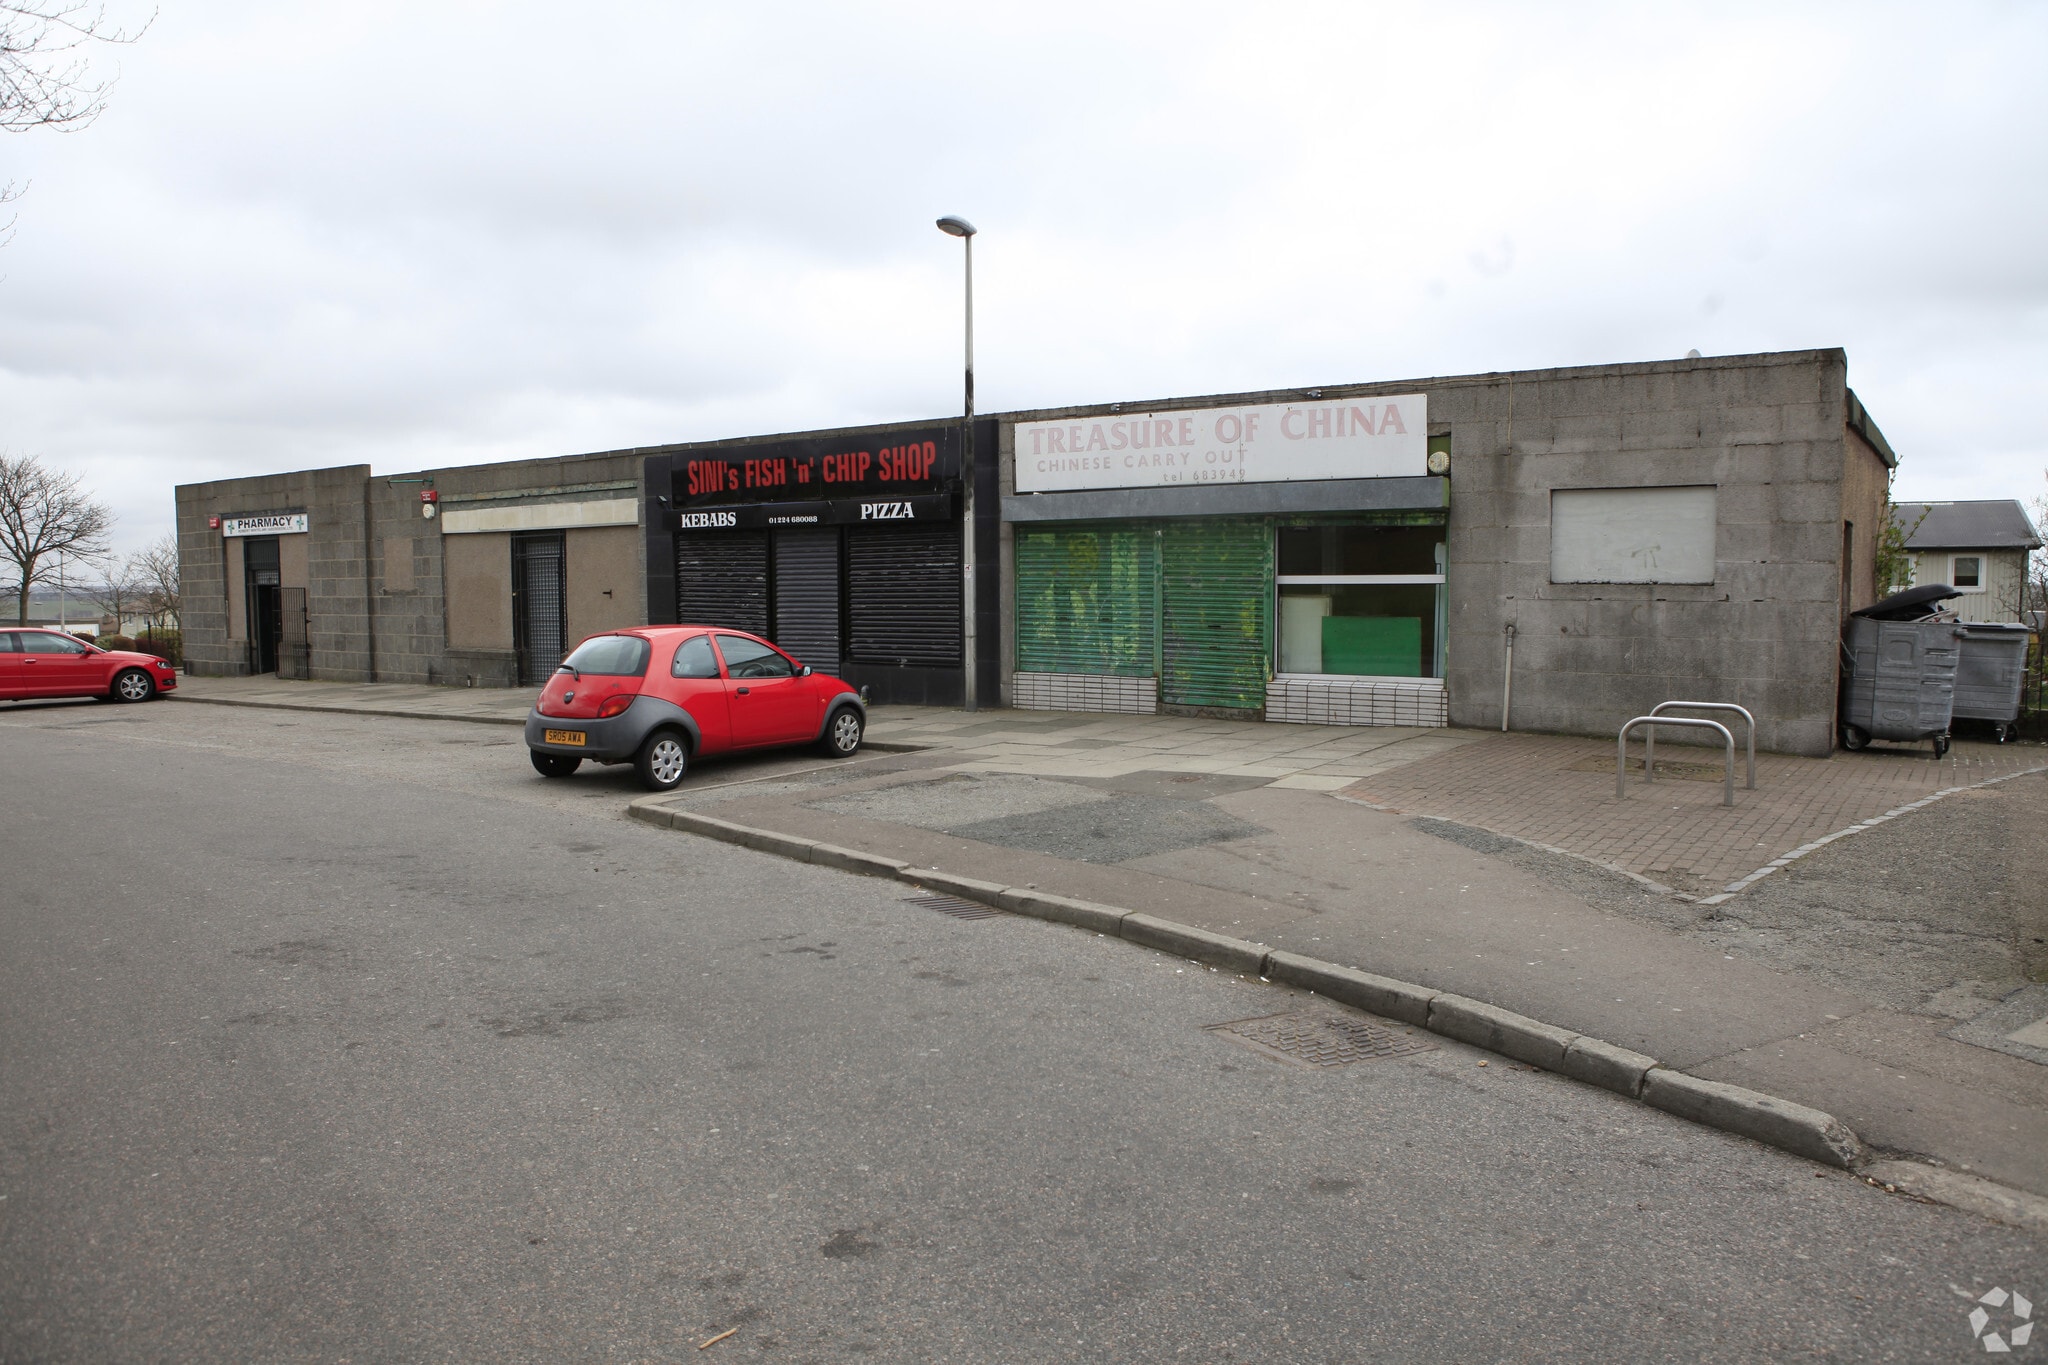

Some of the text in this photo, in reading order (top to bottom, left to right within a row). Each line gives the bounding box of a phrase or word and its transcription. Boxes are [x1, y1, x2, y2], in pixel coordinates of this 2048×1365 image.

[1028, 404, 1408, 455] TREASURE OF CHINA
[688, 441, 936, 495] SINI's FISH 'n' CHIP SHOP
[1037, 450, 1248, 473] CHINESE CARRY OUT
[1163, 468, 1246, 482] tel 683949
[860, 501, 915, 520] PIZZA
[237, 516, 292, 530] PHARMACY
[681, 512, 737, 528] KEBABS
[768, 516, 790, 524] 01224
[548, 730, 567, 742] SR05
